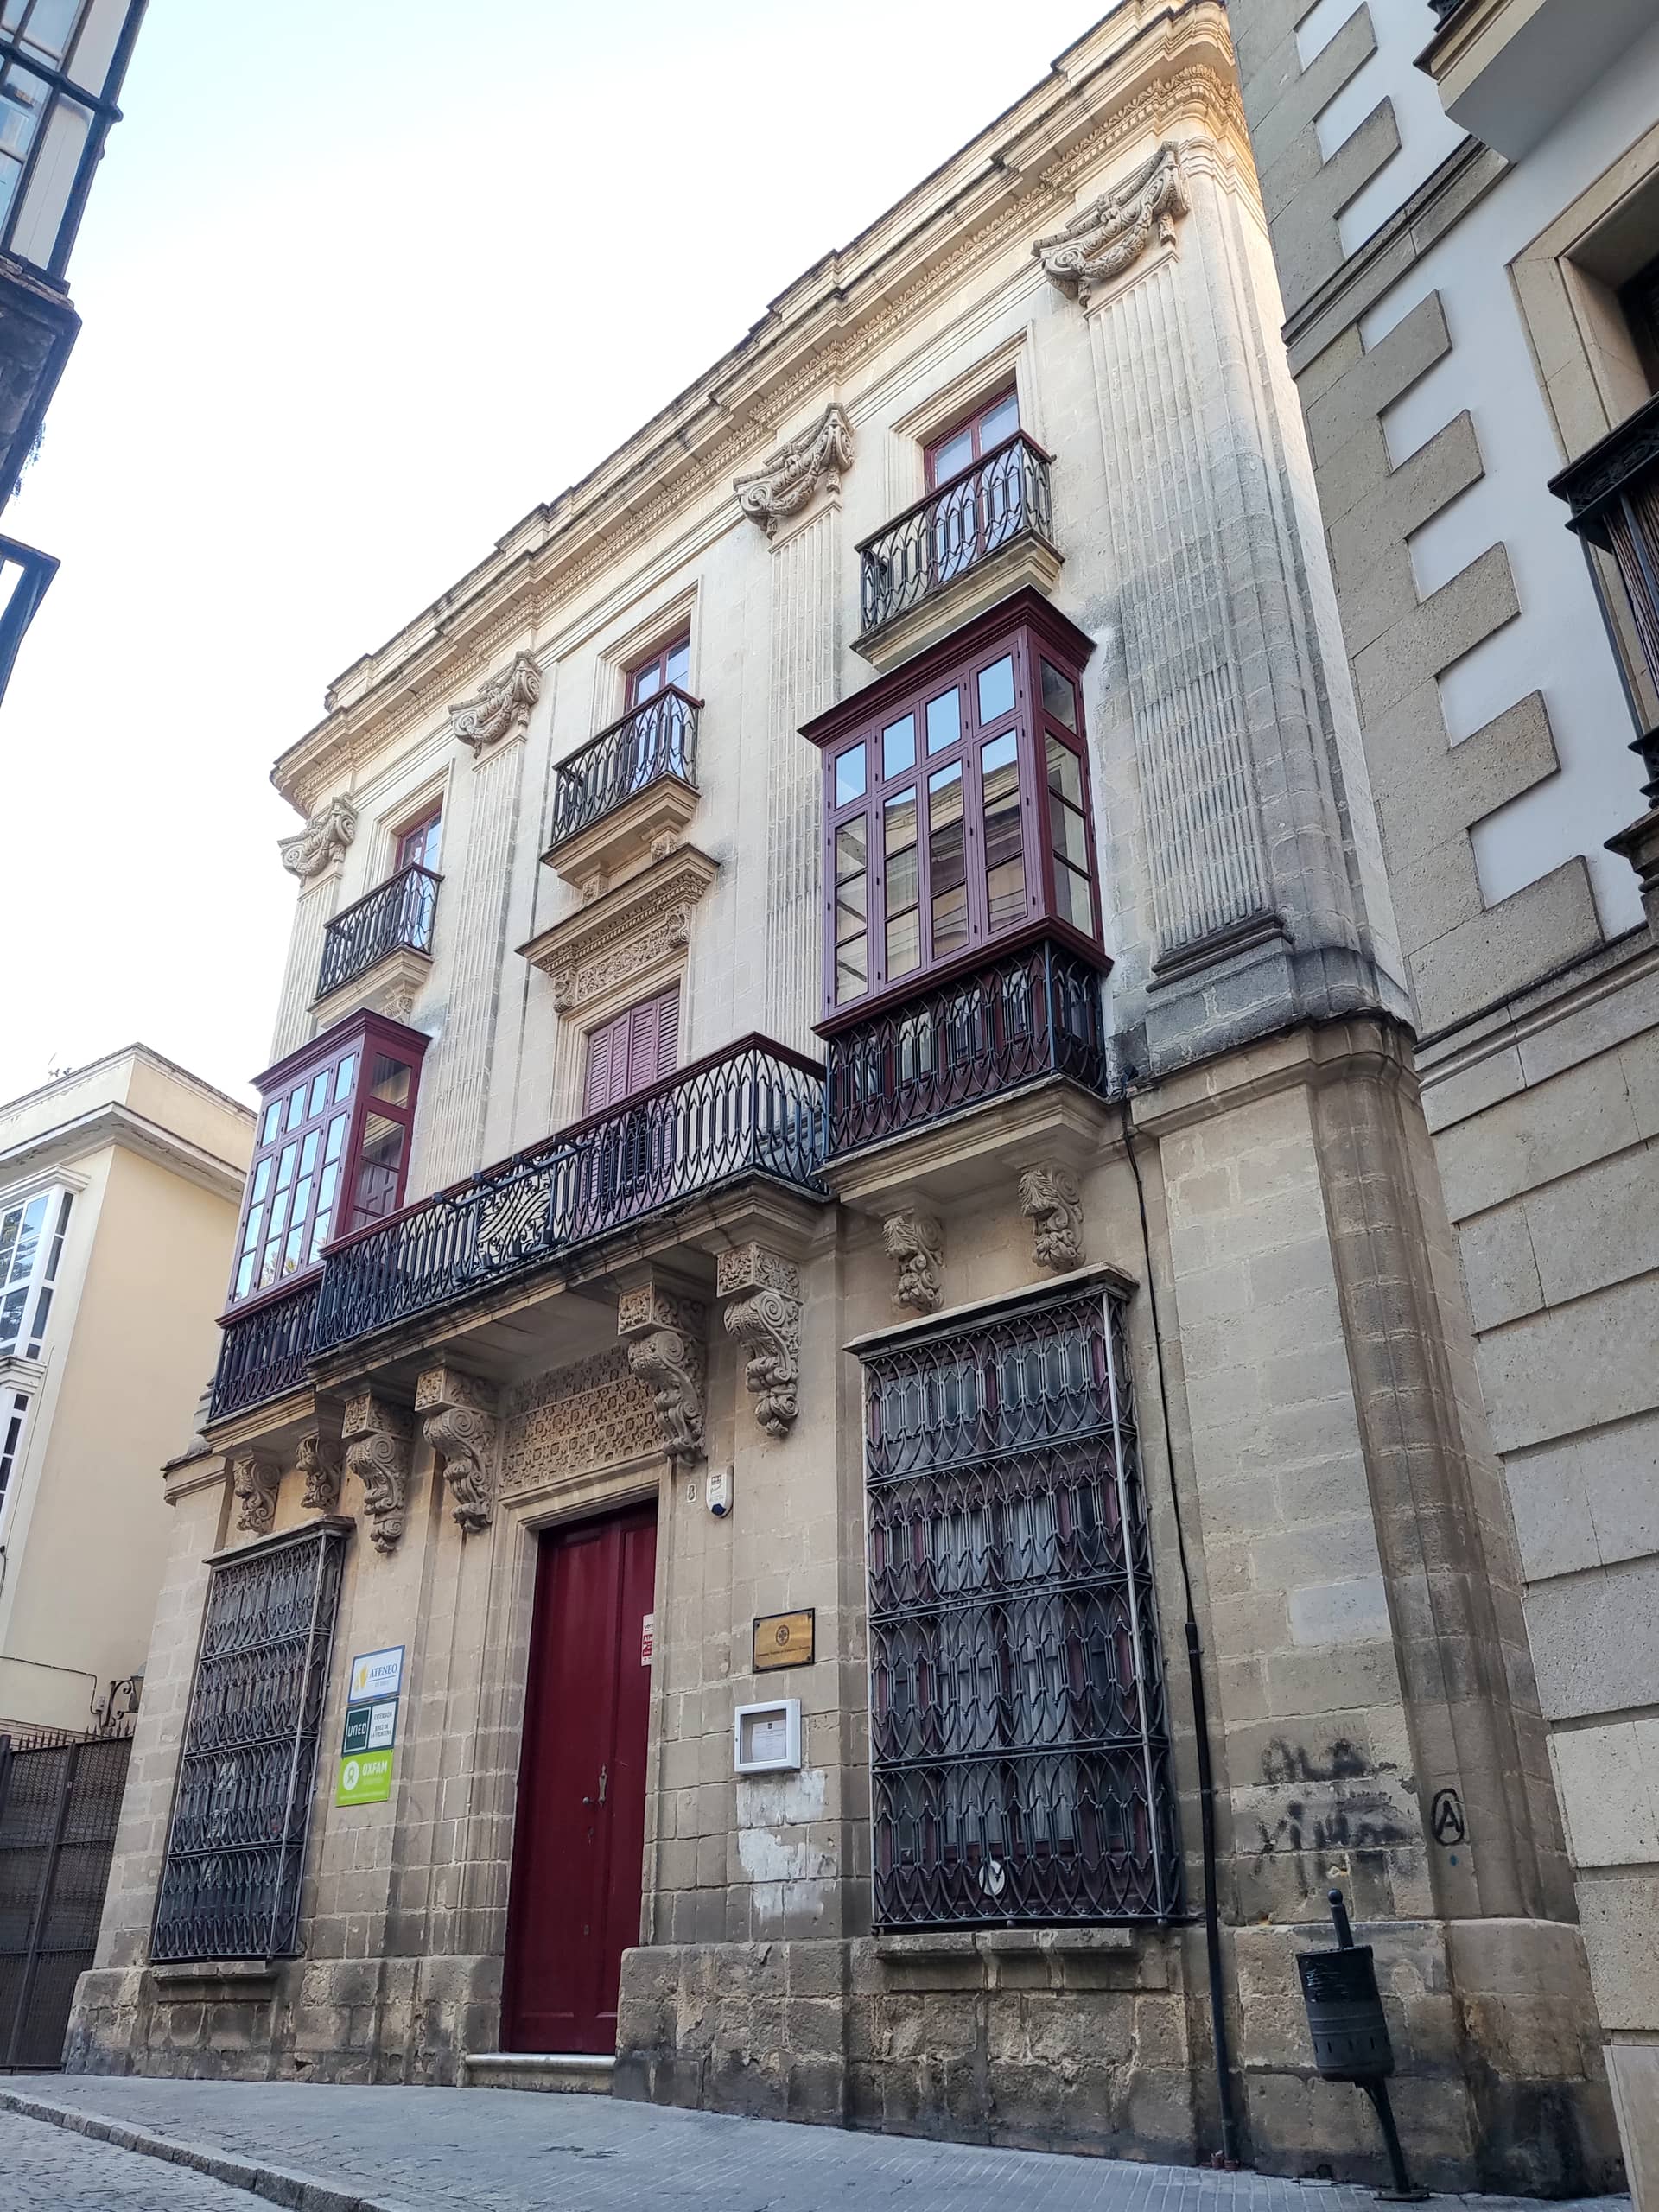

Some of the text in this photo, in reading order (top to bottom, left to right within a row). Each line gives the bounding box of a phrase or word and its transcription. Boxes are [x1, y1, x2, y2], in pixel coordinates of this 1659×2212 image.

[369, 1663, 397, 1679] ATENEO
[347, 1722, 367, 1738] UNED
[362, 1760, 388, 1777] OXFAM
